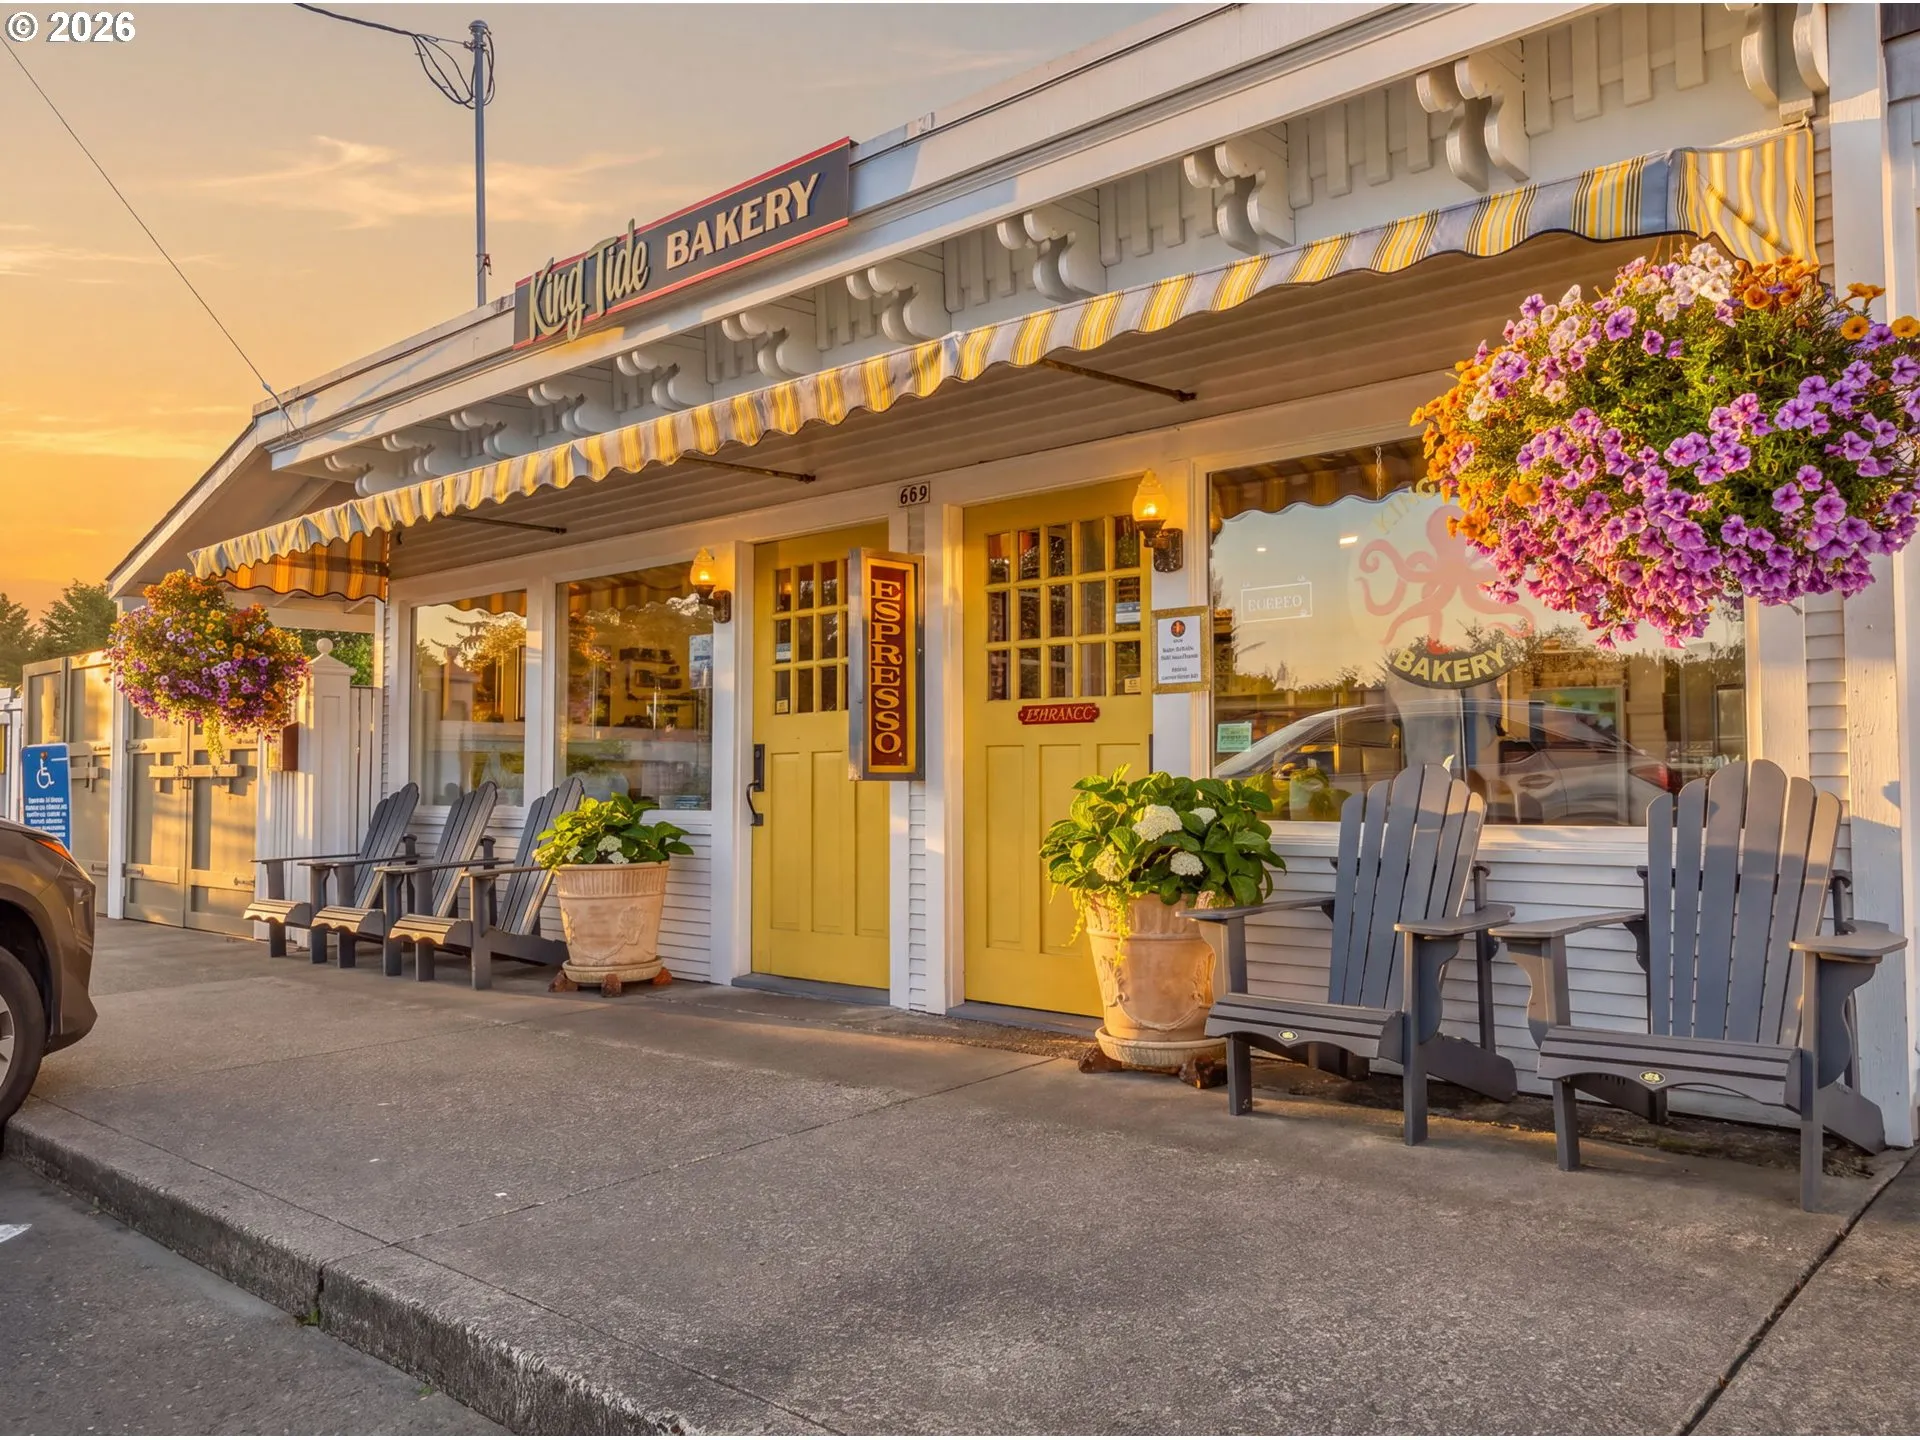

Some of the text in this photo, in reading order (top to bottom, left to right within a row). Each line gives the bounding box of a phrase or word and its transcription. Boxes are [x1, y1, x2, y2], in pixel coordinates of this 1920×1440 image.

[529, 172, 821, 341] King Tide BAKERY
[900, 485, 928, 505] 669
[871, 578, 903, 754] ESPRESSO
[1393, 642, 1506, 683] BAKERY
